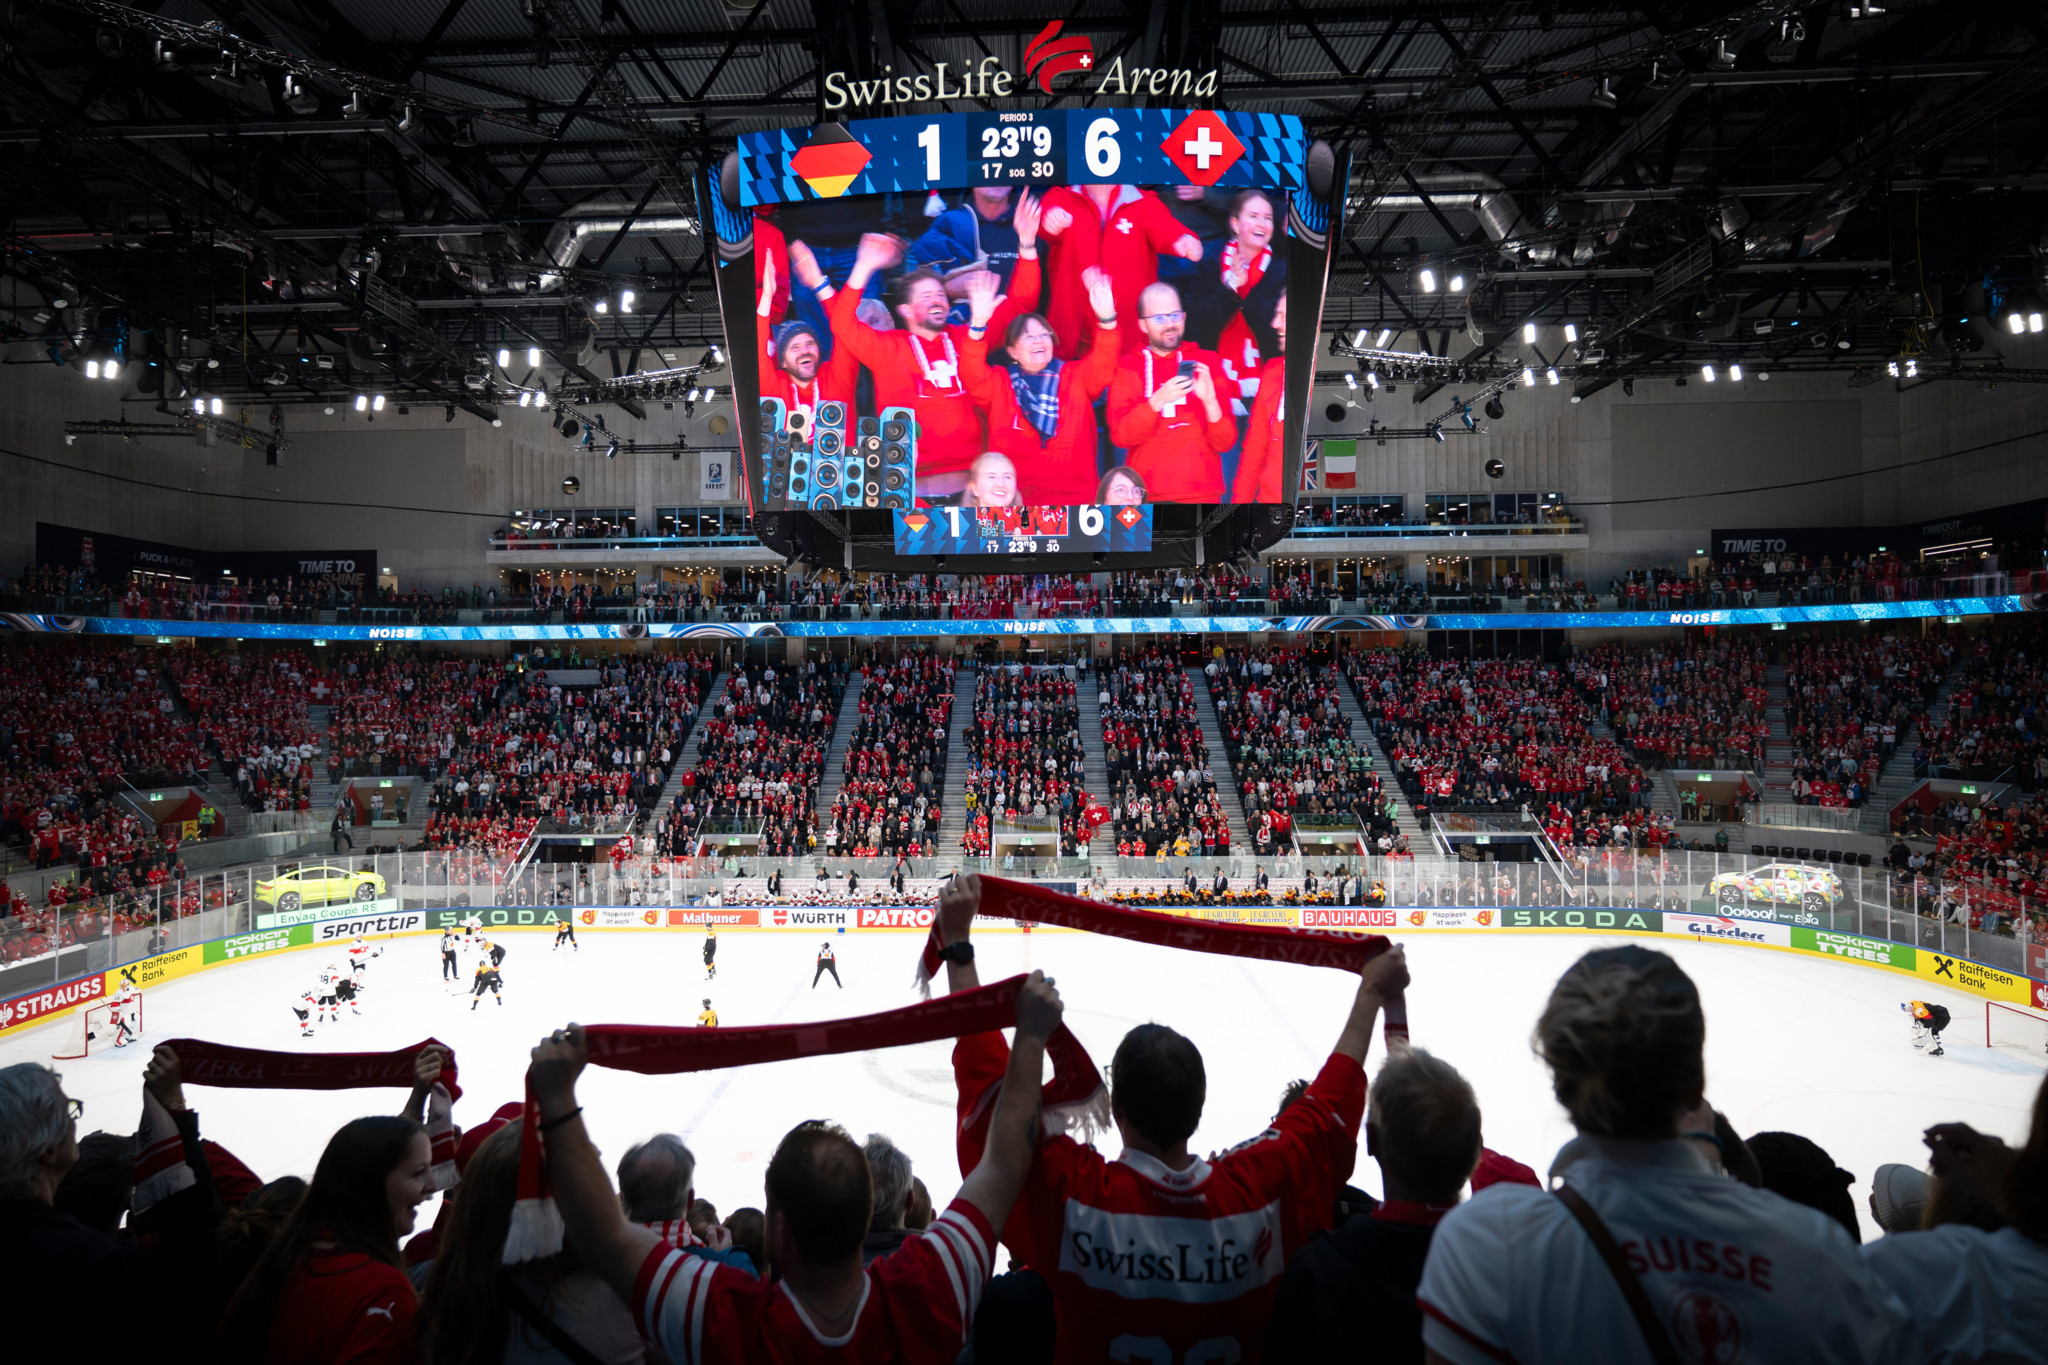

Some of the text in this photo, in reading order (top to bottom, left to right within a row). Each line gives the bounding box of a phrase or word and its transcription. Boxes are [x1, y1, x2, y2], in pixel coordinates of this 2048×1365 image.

[824, 56, 1219, 109] SwissLife Arena
[1000, 113, 1034, 122] PERIOD 3
[918, 124, 940, 181] 1
[1085, 118, 1121, 177] 6
[981, 161, 1054, 178] 17 SOG 30
[945, 506, 960, 537] 1
[1078, 504, 1105, 536] 6
[1922, 520, 1961, 535] TIMEOUT
[987, 545, 999, 553] 17
[1046, 543, 1060, 552] 30
[1723, 539, 1787, 553] TIME TO
[140, 552, 194, 567] PUCK & PLATE
[299, 560, 355, 573] TIME TO
[321, 573, 365, 585] SHINE
[1004, 621, 1046, 633] NOISE
[1669, 612, 1721, 625] NOISE
[369, 628, 415, 640] NOISE
[280, 912, 316, 924] Enyaq
[320, 905, 358, 921] Coupé
[683, 912, 742, 924] Malbuner
[1304, 911, 1396, 925] BAUHAUS
[225, 938, 289, 958] TYRES
[1817, 942, 1890, 963] TYRES
[142, 951, 188, 972] Raiffeisen
[142, 968, 165, 982] Bank
[1959, 962, 2013, 986] Raiffeisen
[1960, 973, 1986, 990] Bank
[16, 978, 101, 1019] STRAUSS
[1072, 1232, 1248, 1284] SwissLife
[1622, 1235, 1772, 1292] SUISSE
